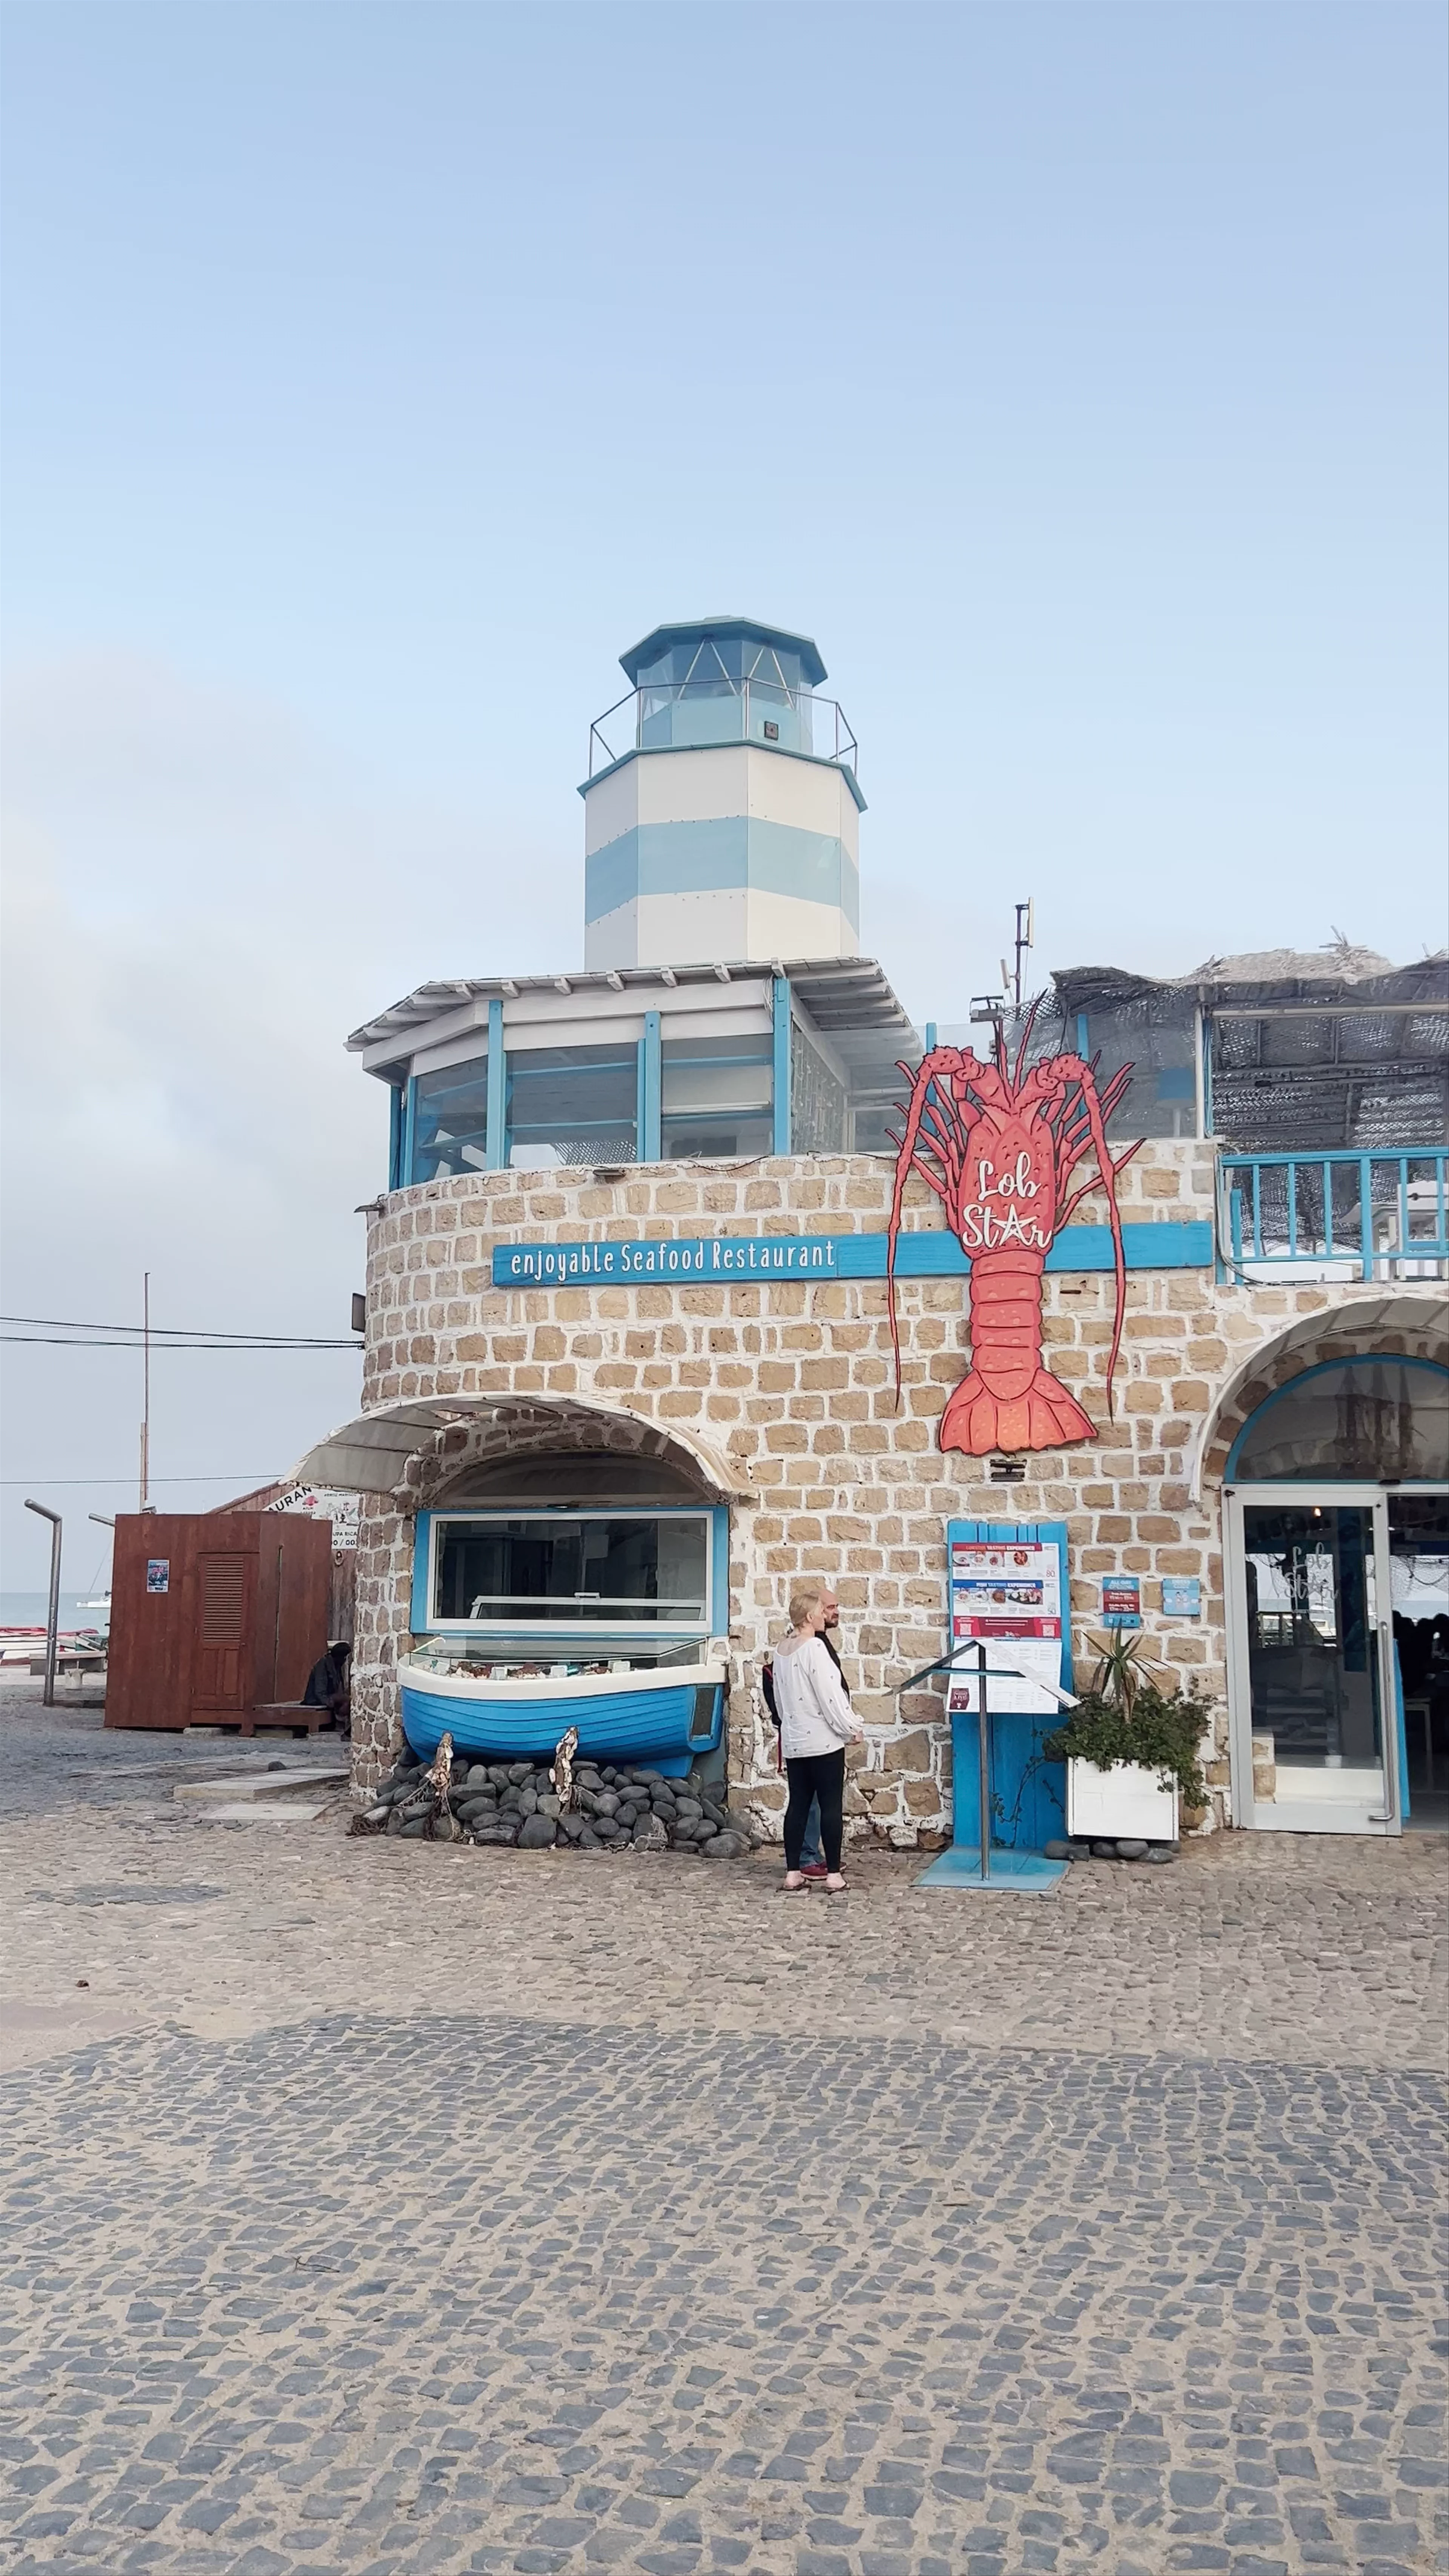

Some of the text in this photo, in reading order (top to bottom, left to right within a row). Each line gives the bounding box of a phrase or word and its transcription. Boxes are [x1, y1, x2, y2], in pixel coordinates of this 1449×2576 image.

[978, 1151, 1041, 1201] Lob
[511, 1240, 835, 1281] enjoyable Seafood Restaurant
